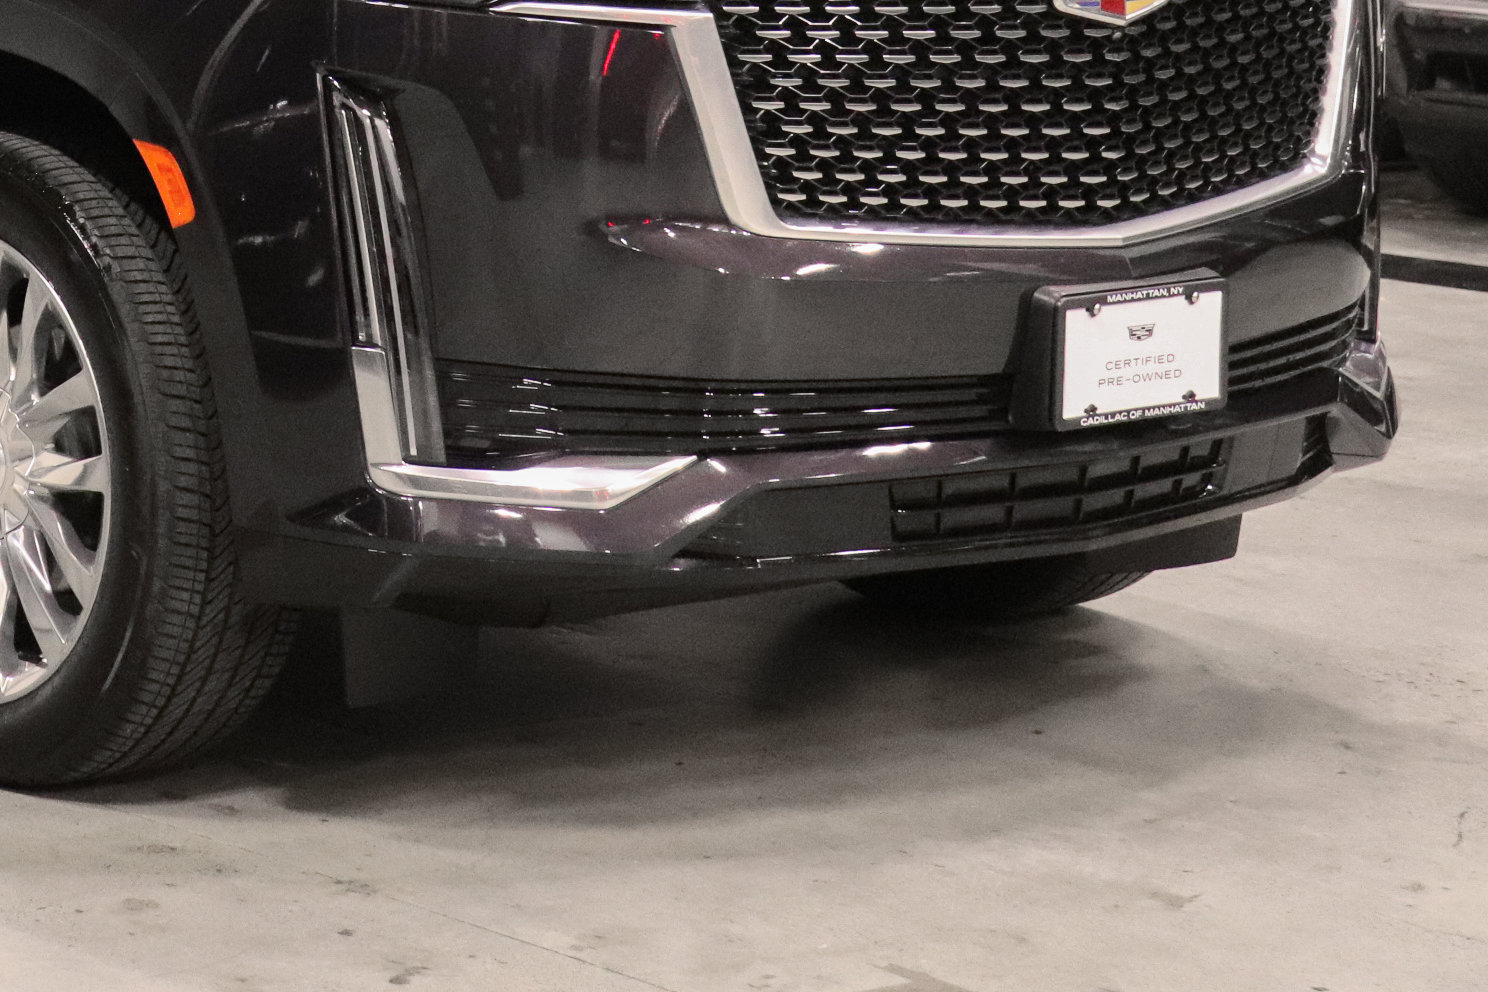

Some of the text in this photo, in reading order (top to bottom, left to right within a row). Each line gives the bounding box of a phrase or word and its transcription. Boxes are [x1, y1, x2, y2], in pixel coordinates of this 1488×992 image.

[1107, 286, 1184, 303] MANHATTAN, NY
[1105, 353, 1175, 371] CERTIFIED
[1097, 369, 1182, 388] PRE-OWNED
[1080, 401, 1206, 426] CADILLAC OF MANHATTAN
